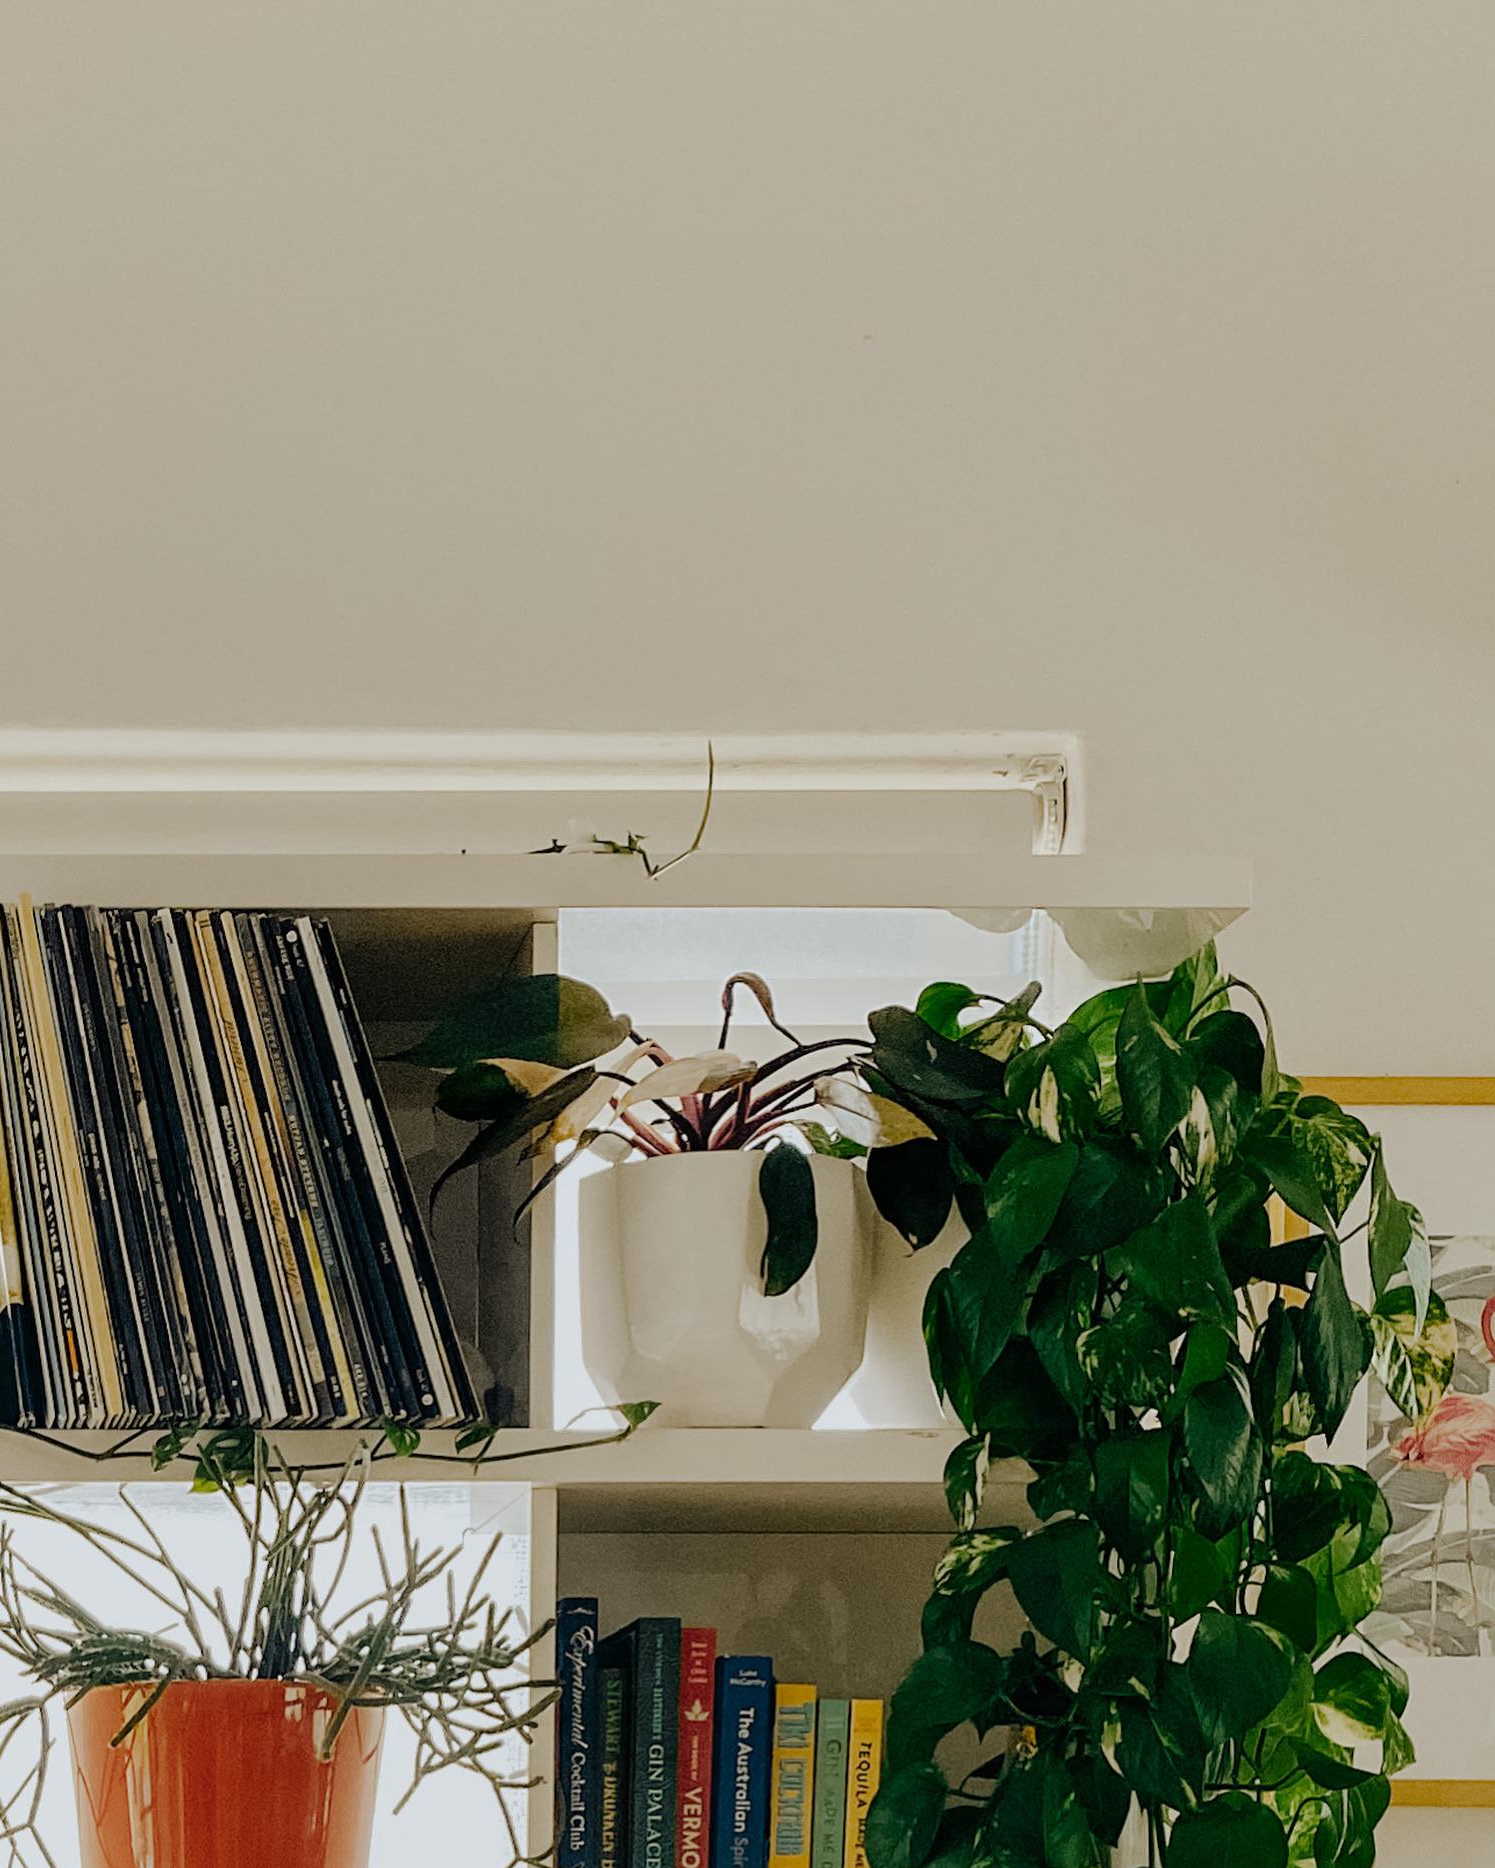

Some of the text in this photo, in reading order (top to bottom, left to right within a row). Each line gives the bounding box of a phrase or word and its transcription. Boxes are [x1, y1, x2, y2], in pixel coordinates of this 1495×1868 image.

[563, 1625, 594, 1851] Experimental Cocktail Club
[737, 1706, 754, 1739] The
[777, 1701, 812, 1749] TIKI
[648, 1743, 663, 1782] GIN
[824, 1739, 841, 1777] GIN
[855, 1741, 872, 1809] TEQUILA
[733, 1742, 753, 1833] Australian
[600, 1776, 616, 1852] DRUNKEN
[822, 1833, 834, 1854] ME
[854, 1853, 863, 1868] ME
